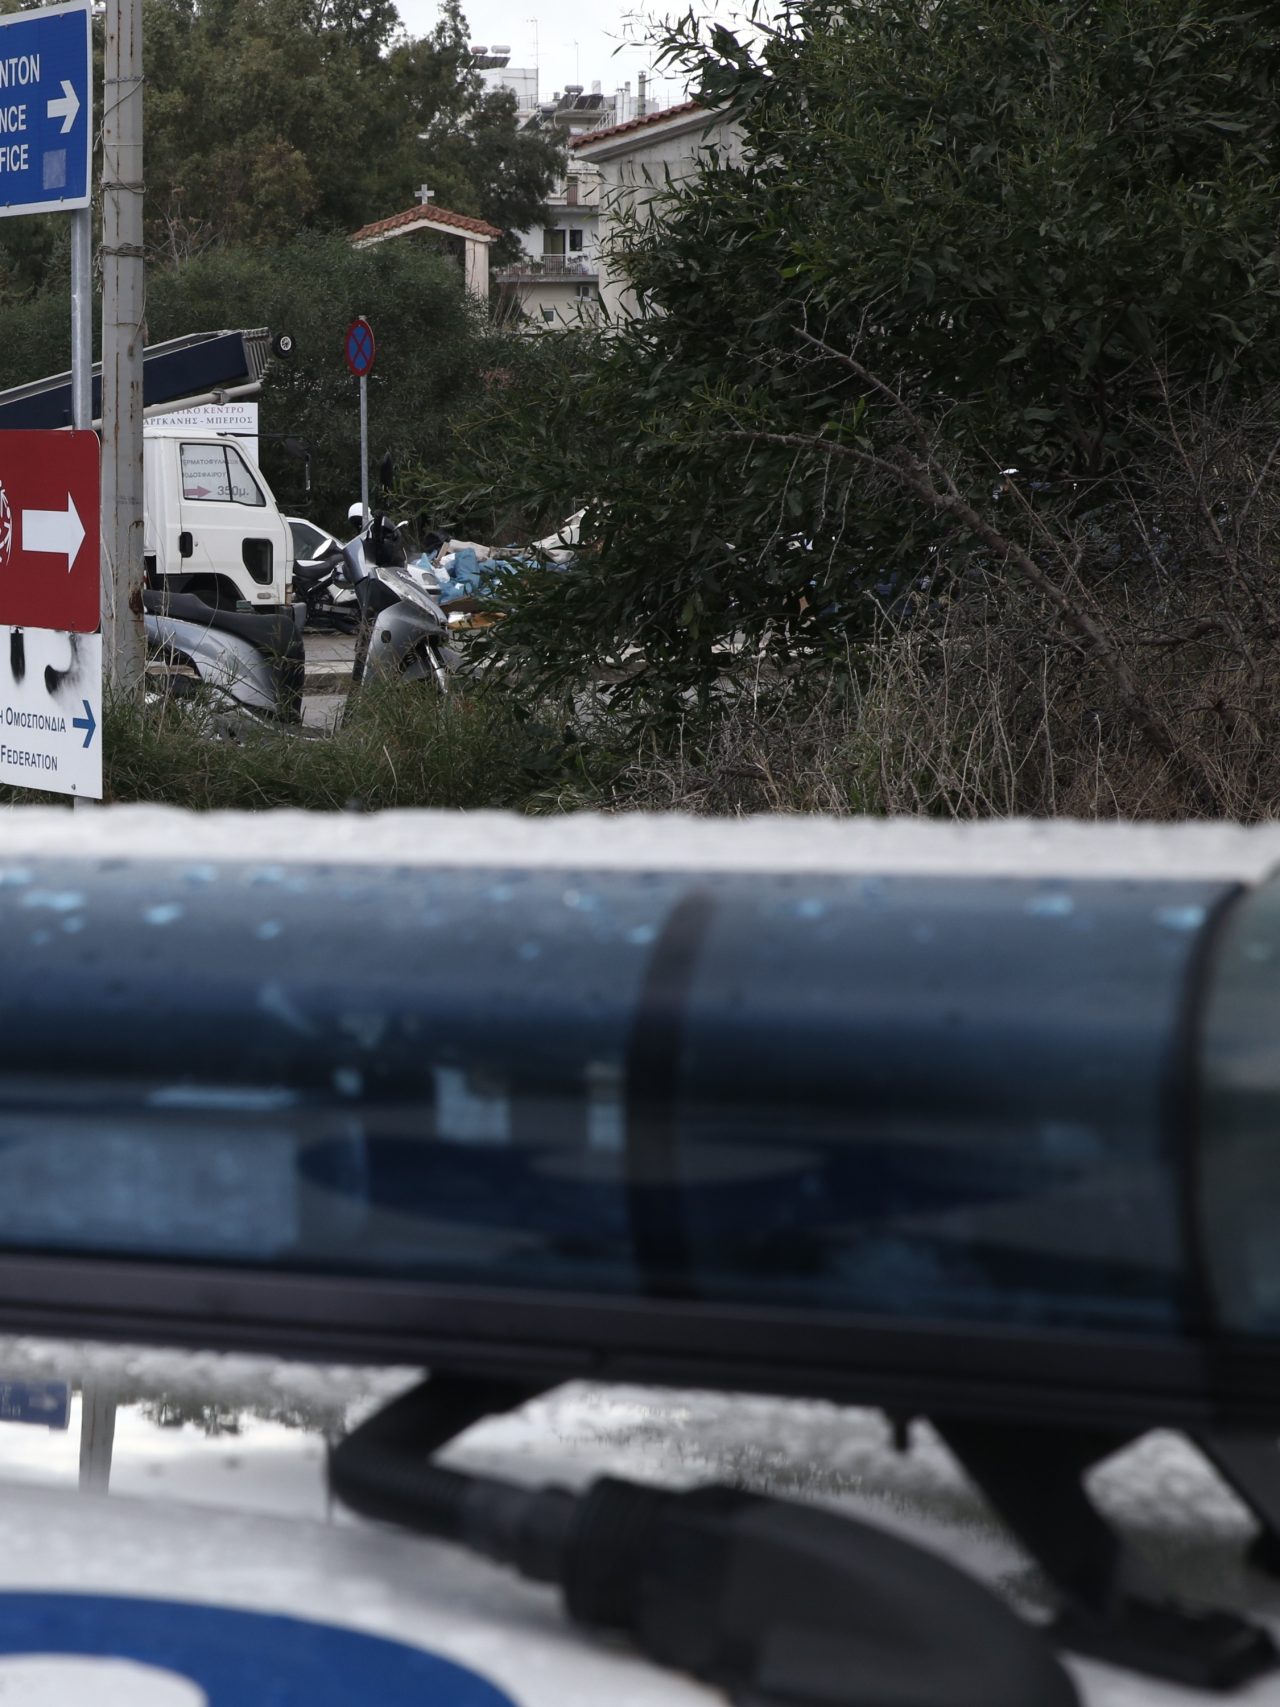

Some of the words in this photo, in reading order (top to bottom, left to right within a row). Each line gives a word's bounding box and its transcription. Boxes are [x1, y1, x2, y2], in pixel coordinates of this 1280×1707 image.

[203, 406, 244, 415] ΚΕΝΤΡΟ
[143, 417, 198, 426] ΑΡΓΚΑΝΗΣ
[206, 416, 253, 425] ΜΠΕΡΙΟΣ
[5, 707, 66, 733] ΟΜΟΣΠΟΝΔΙΑ
[0, 744, 58, 772] FEDERATION
